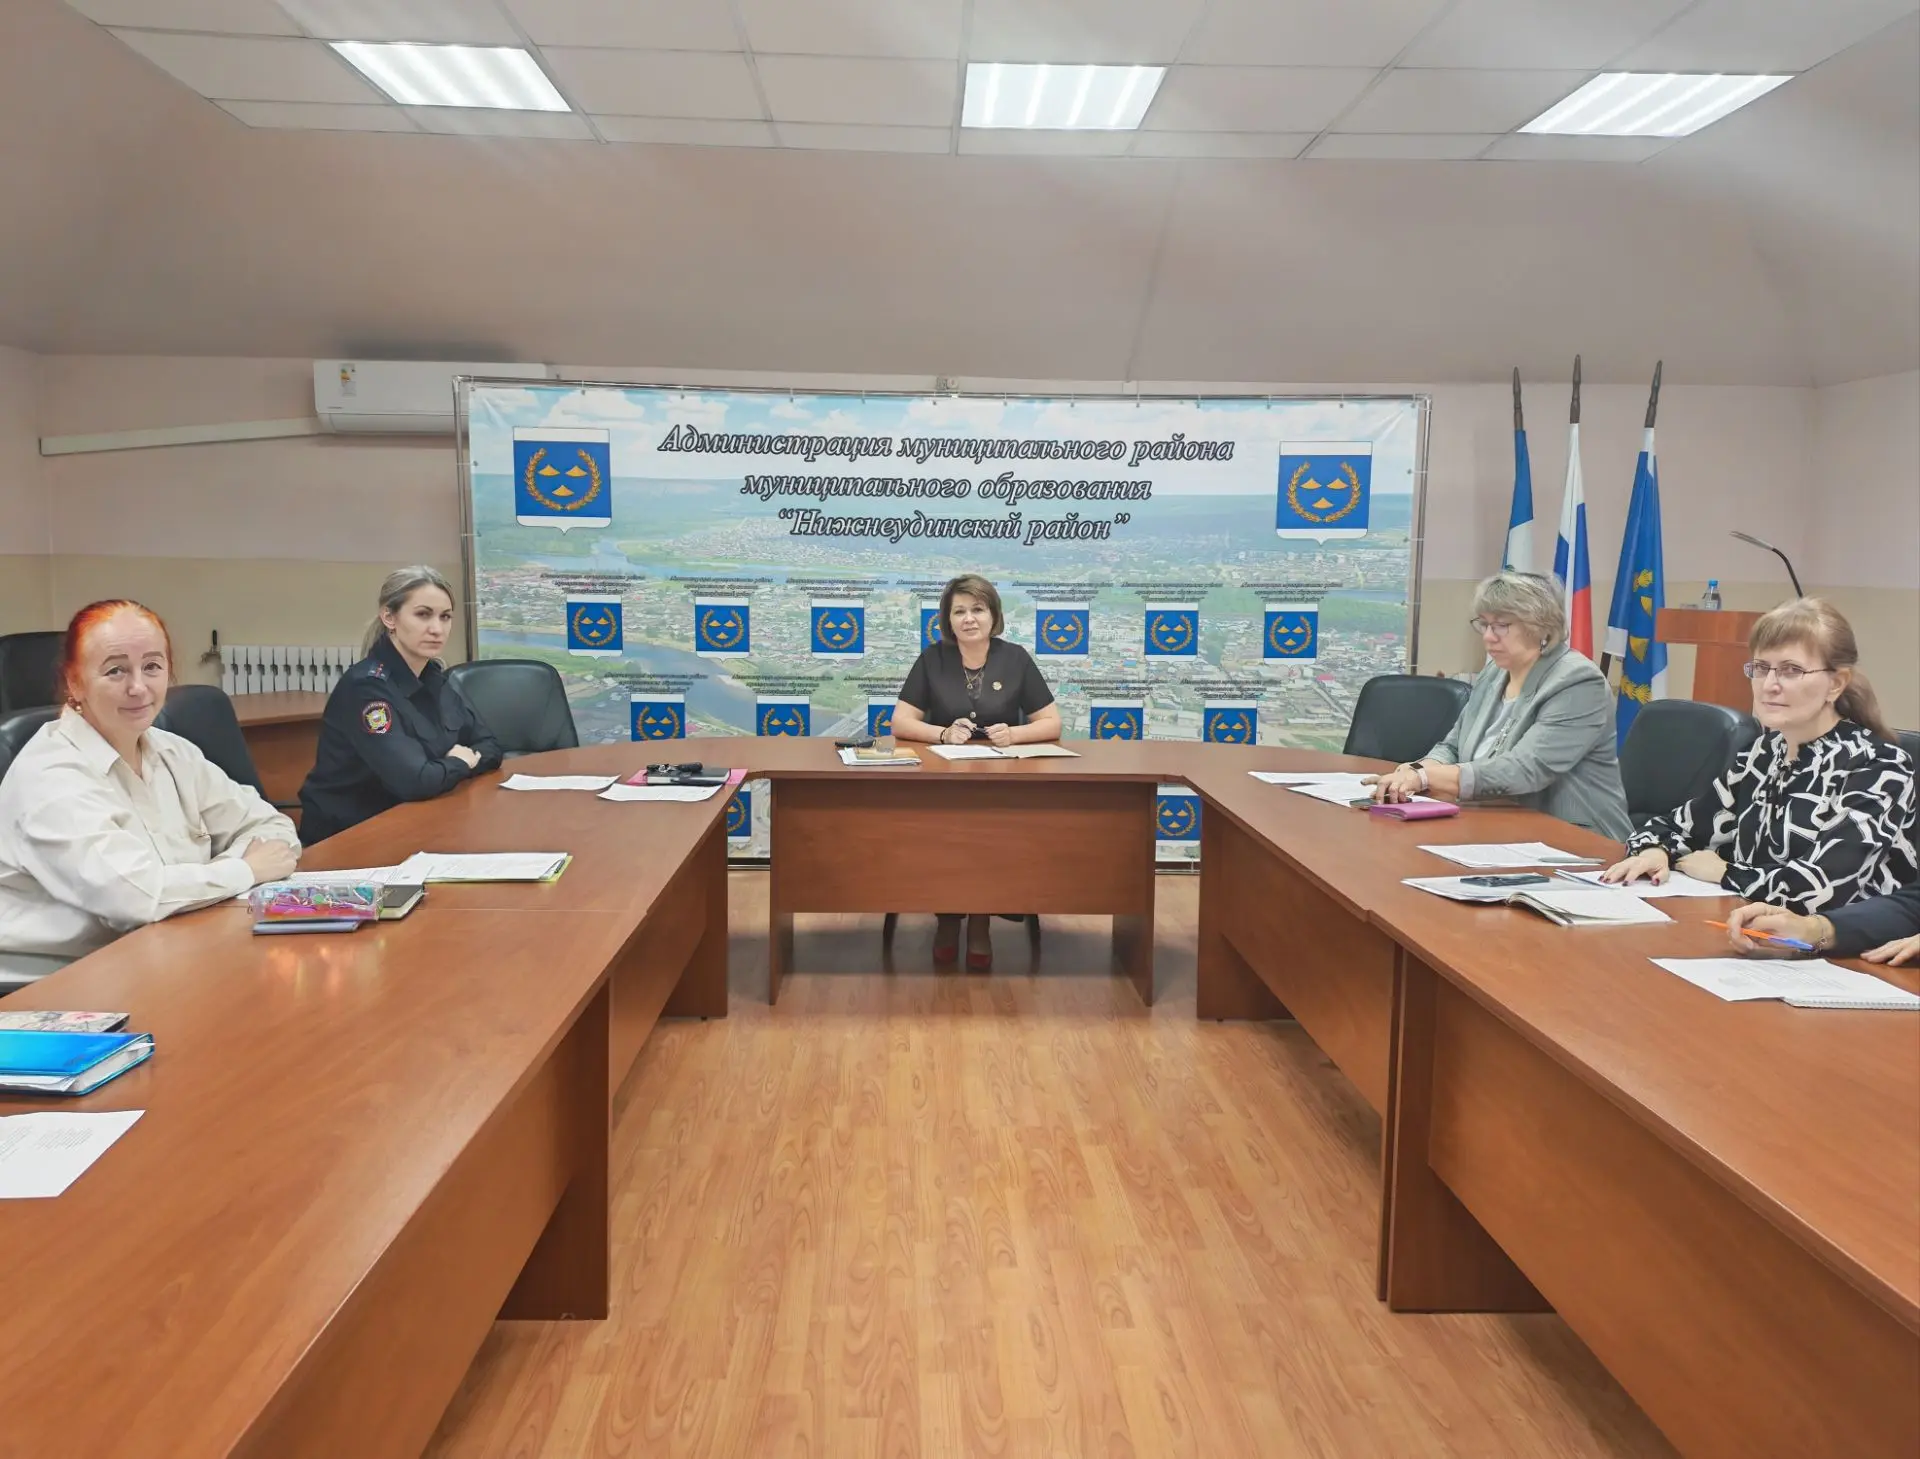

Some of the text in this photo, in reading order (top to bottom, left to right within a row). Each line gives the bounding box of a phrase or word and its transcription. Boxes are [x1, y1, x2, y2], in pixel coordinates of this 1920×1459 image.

[657, 424, 1235, 466] Администрация муниципального района
[740, 471, 1152, 505] муниципального образования
